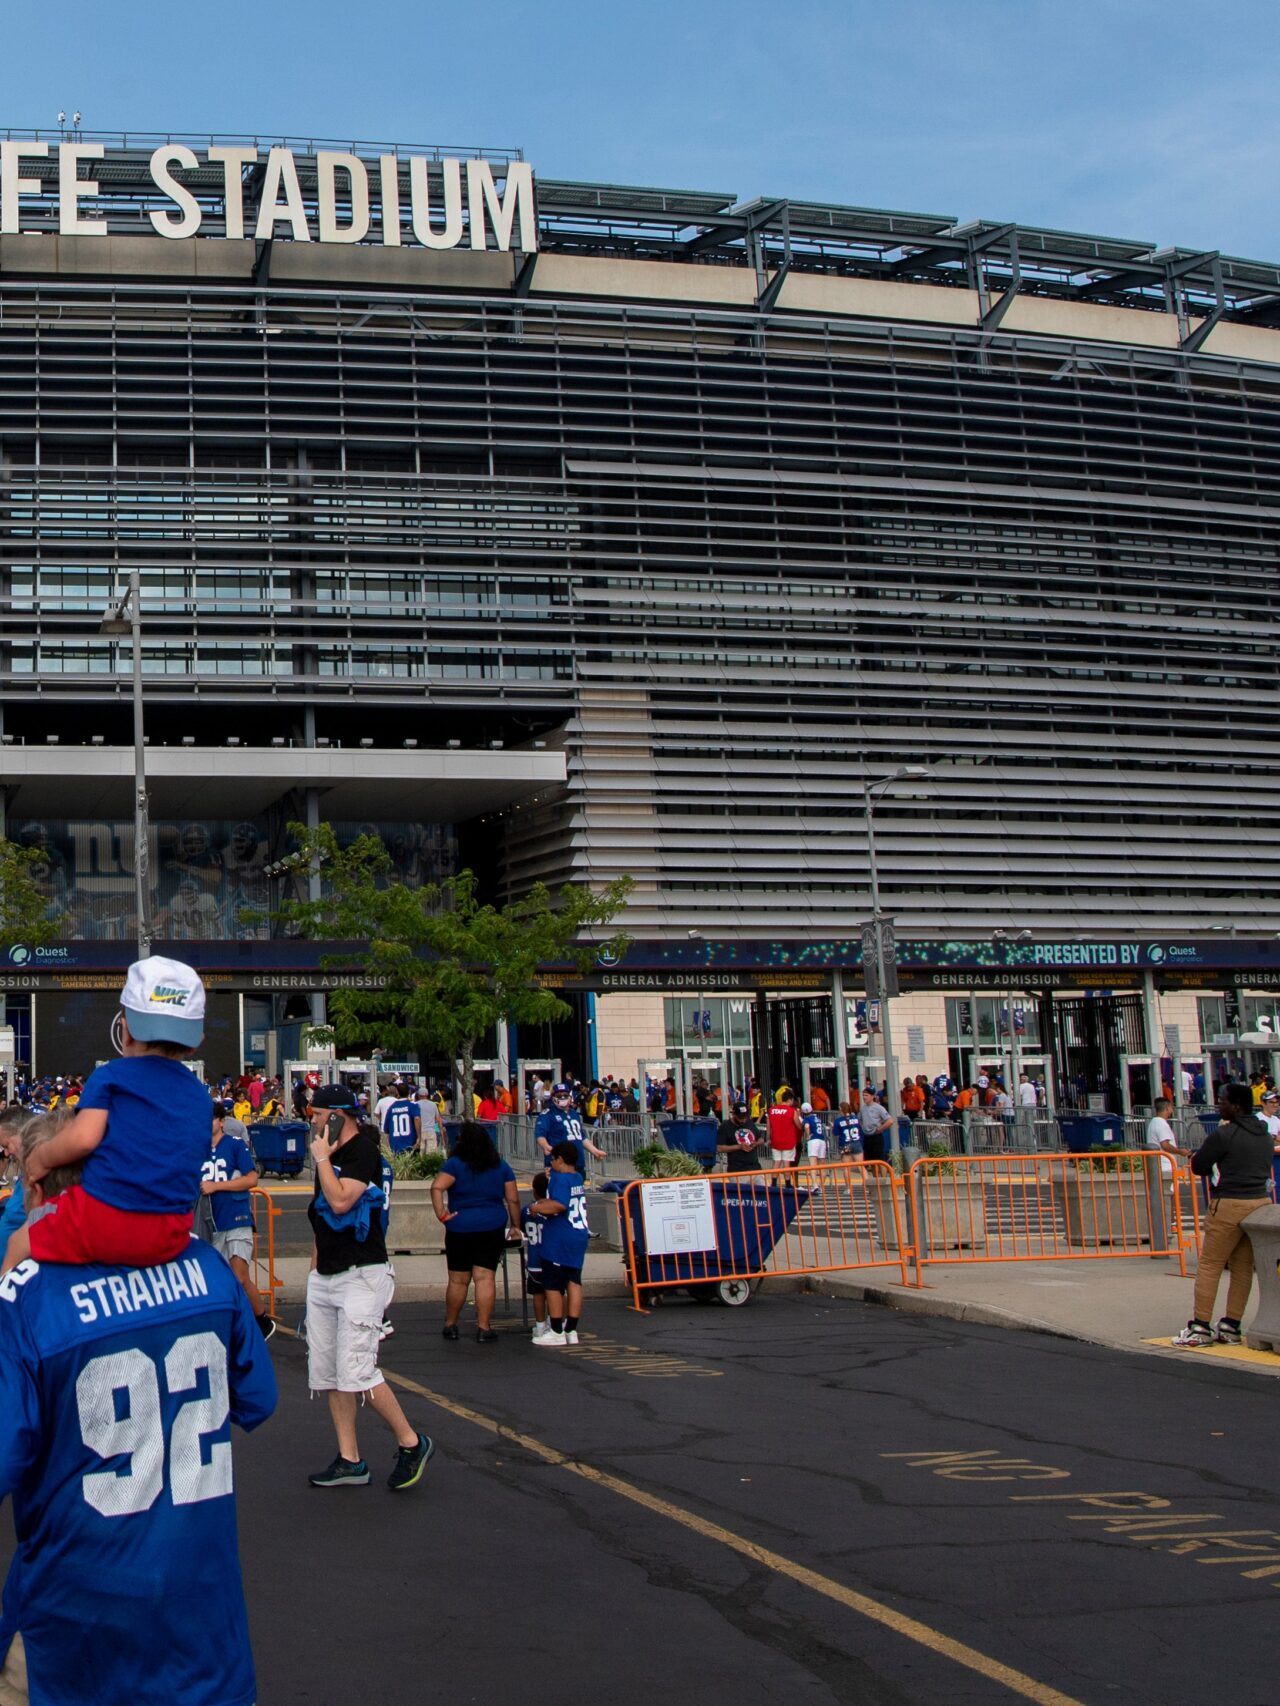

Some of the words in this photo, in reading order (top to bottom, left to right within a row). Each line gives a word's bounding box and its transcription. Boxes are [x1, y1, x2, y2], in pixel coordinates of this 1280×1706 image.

[149, 145, 536, 253] STADIUM
[35, 946, 68, 957] Quest
[1034, 944, 1117, 964] PRESENTED
[1122, 944, 1139, 964] BY
[1169, 946, 1196, 955] Quest
[253, 976, 316, 986] GENERAL
[322, 976, 391, 986] ADMISSIO
[602, 975, 662, 985] GENERAL
[668, 975, 739, 985] ADMISSION
[933, 974, 989, 984] GENERAL
[994, 974, 1060, 984] ADMISSION
[1234, 974, 1280, 984] GENERA
[151, 986, 190, 1006] NIKE
[392, 1114, 410, 1136] 10
[563, 1119, 582, 1140] 10
[200, 1159, 228, 1182] 26
[70, 1258, 208, 1323] STRAHAN
[76, 1331, 233, 1517] 92
[878, 1450, 1071, 1481] NO
